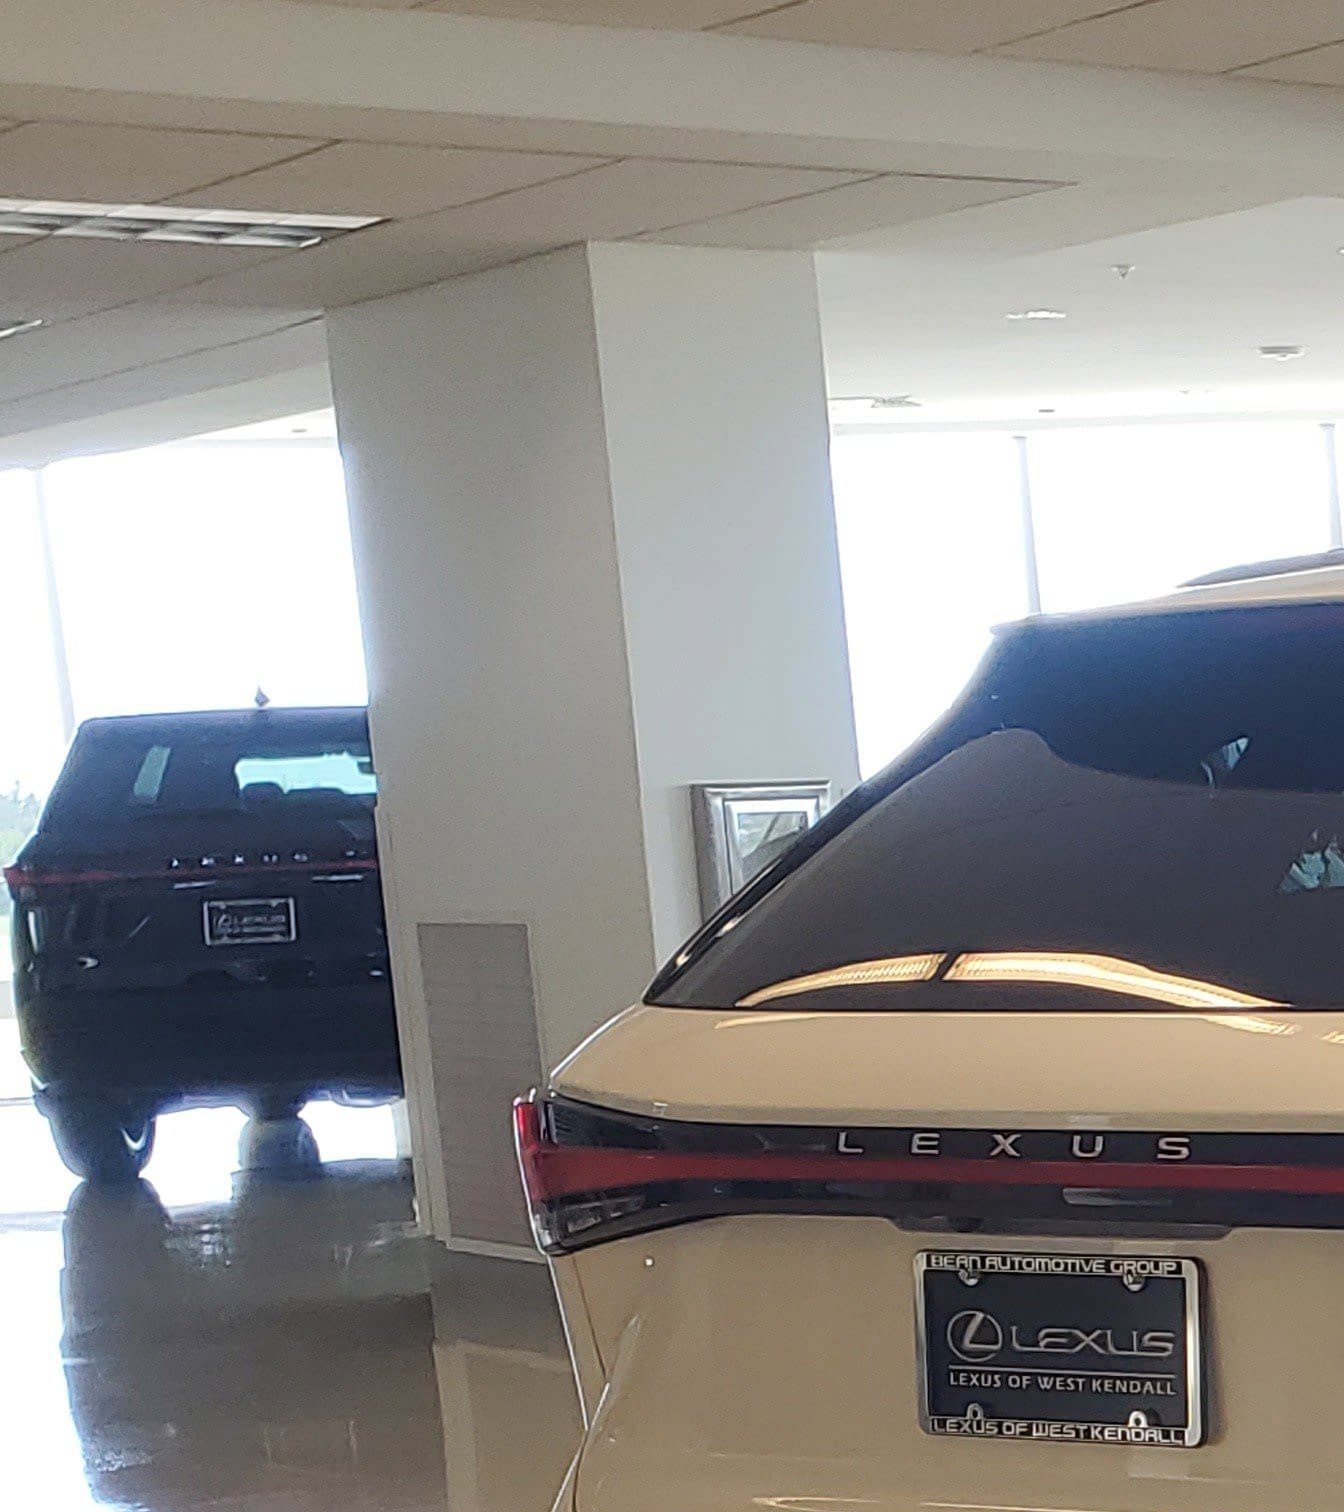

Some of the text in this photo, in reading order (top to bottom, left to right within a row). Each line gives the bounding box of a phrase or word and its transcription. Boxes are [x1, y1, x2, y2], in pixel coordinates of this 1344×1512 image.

[837, 1131, 1192, 1160] LEXUS
[931, 1256, 1177, 1275] BEAN AUTOMOTIVE GROUP
[1010, 1325, 1176, 1357] LEXUS
[950, 1371, 1177, 1395] LEXUS OF WEST KENDALL
[933, 1418, 1185, 1445] LEXUS OF WEST KENDALL
